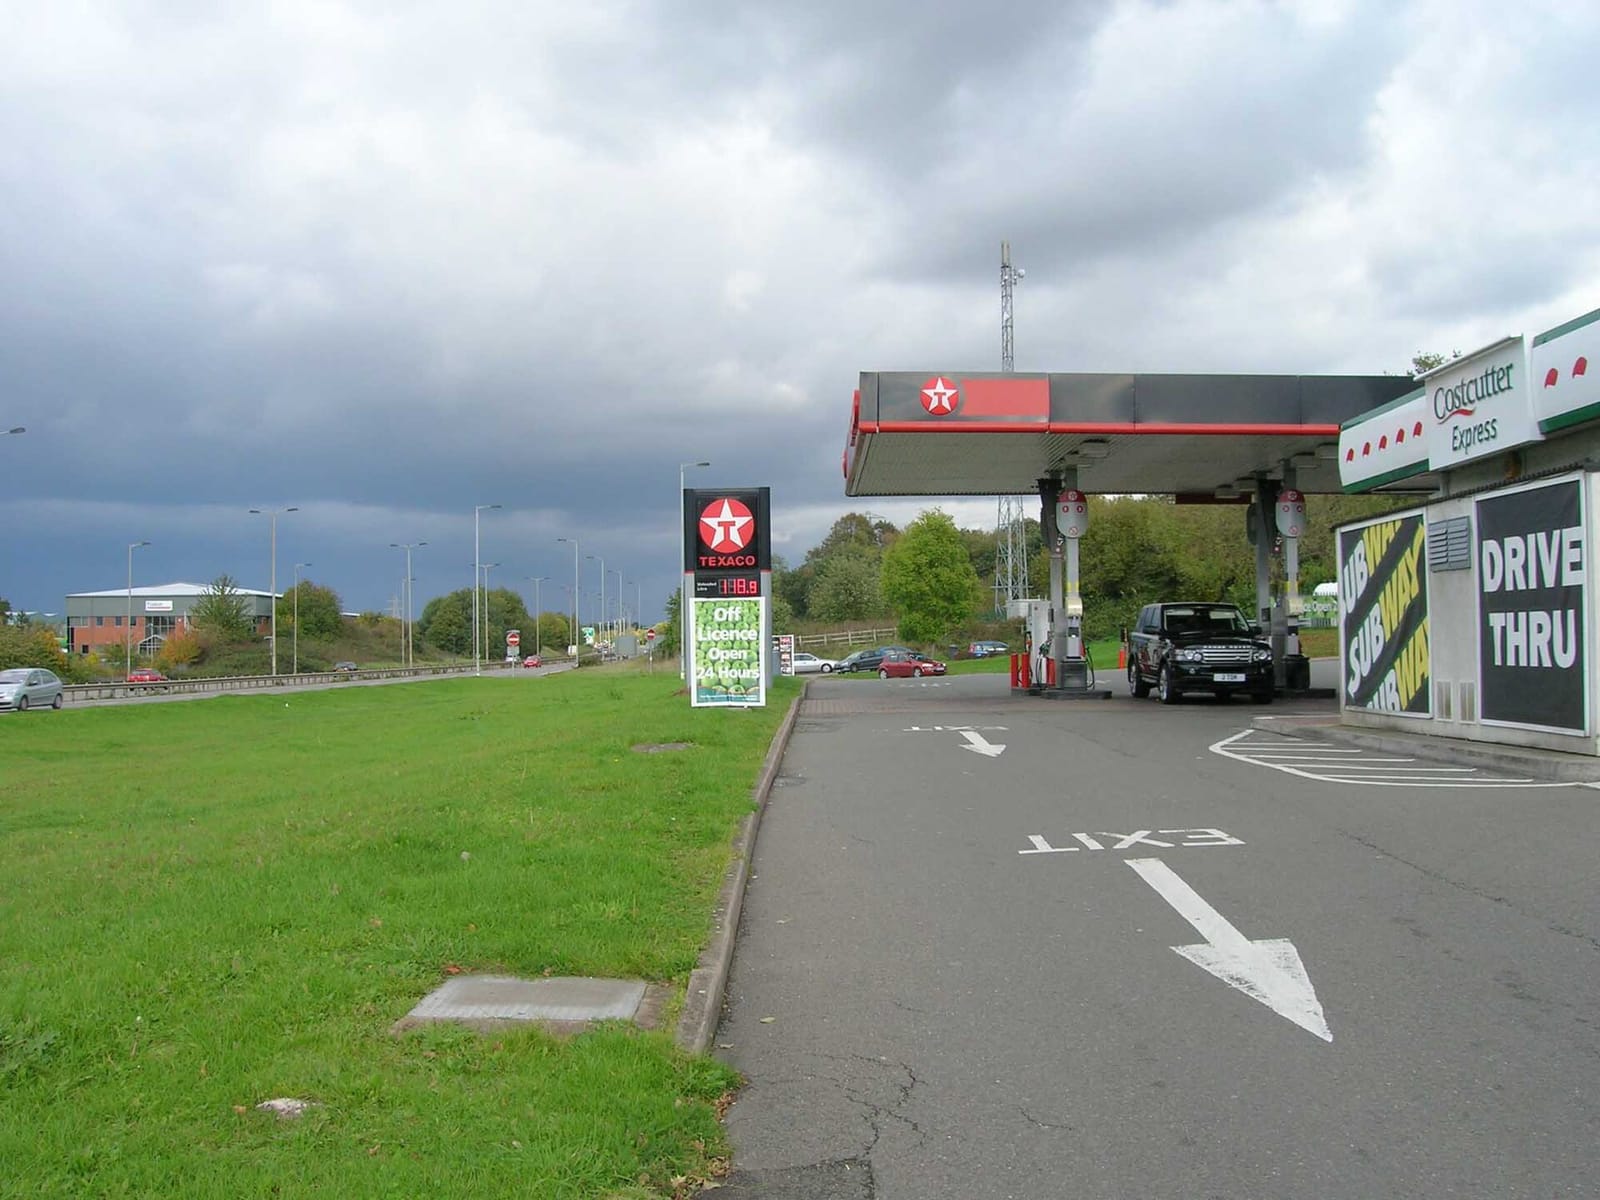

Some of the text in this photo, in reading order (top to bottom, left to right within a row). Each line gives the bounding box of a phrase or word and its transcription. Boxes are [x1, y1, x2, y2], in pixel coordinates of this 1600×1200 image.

[1433, 363, 1513, 420] Costcutter
[1451, 418, 1498, 454] Express
[699, 555, 756, 567] TEXACO
[1341, 520, 1402, 620] UBWA
[1482, 526, 1585, 592] DRIVE
[721, 578, 758, 595] 118.9
[713, 606, 742, 621] Off
[1348, 523, 1425, 697] SUBWAY
[697, 626, 758, 641] Licence
[1489, 609, 1576, 668] THRU
[709, 647, 748, 663] Open
[1367, 615, 1430, 712] BWA
[696, 665, 760, 679] 24 Hours
[1018, 828, 1247, 854] EXIT
